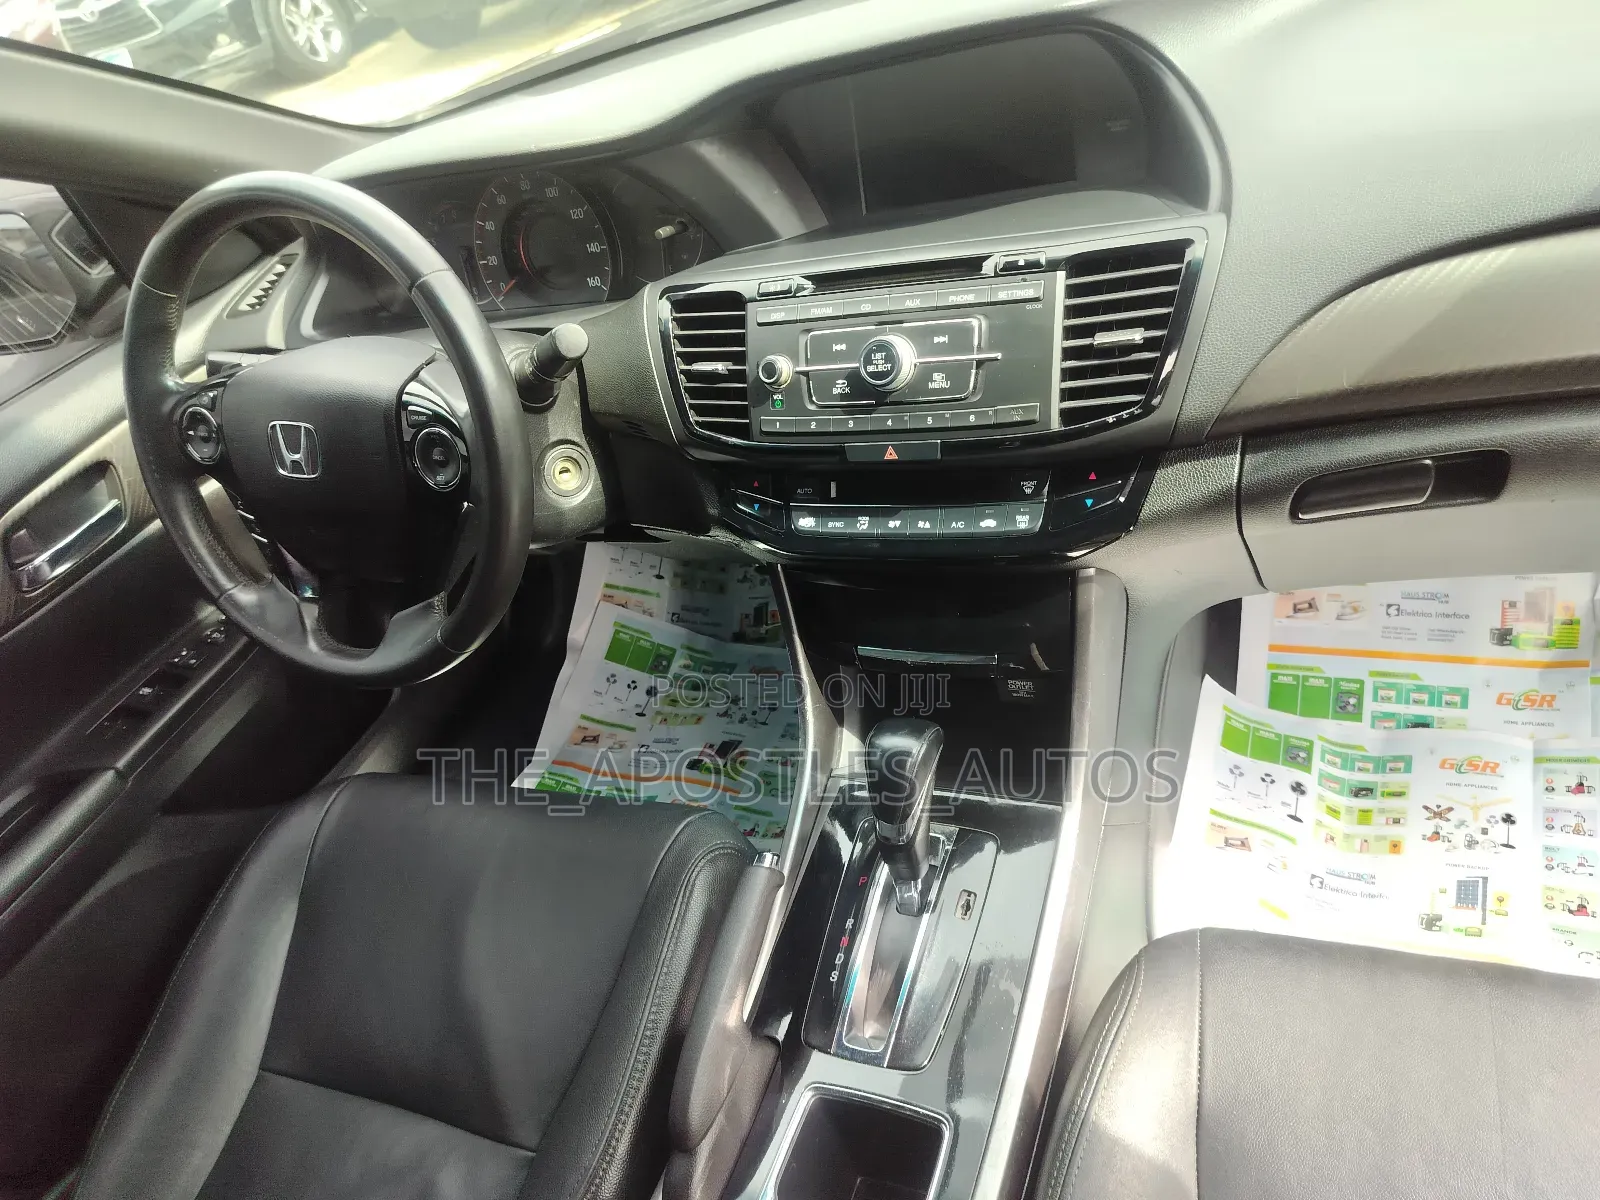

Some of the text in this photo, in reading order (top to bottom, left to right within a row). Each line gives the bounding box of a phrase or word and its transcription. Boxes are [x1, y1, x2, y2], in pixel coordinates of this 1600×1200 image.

[545, 186, 559, 198] 100
[570, 207, 584, 219] 120
[485, 221, 495, 231] 40
[586, 242, 600, 253] 140
[487, 255, 498, 266] 20
[586, 276, 601, 287] 160
[949, 293, 976, 302] PHONE
[997, 288, 1034, 299] SETTINGS
[904, 298, 921, 306] AUX
[810, 306, 833, 316] FM/AM
[860, 303, 872, 311] CD
[770, 312, 786, 320] DISP
[871, 352, 886, 360] LIST
[866, 363, 892, 372] SELECT
[928, 381, 951, 389] MENU
[832, 387, 851, 395] BACK
[926, 416, 933, 425] 5
[969, 414, 976, 422] 6
[810, 421, 817, 429] 2
[848, 420, 854, 428] 3
[886, 419, 893, 427] 4
[950, 521, 965, 529] A/C
[1435, 610, 1470, 620] Interface
[858, 876, 868, 886] P
[845, 918, 855, 929] R
[839, 936, 850, 947] N
[834, 953, 845, 964] D
[829, 970, 838, 982] S
